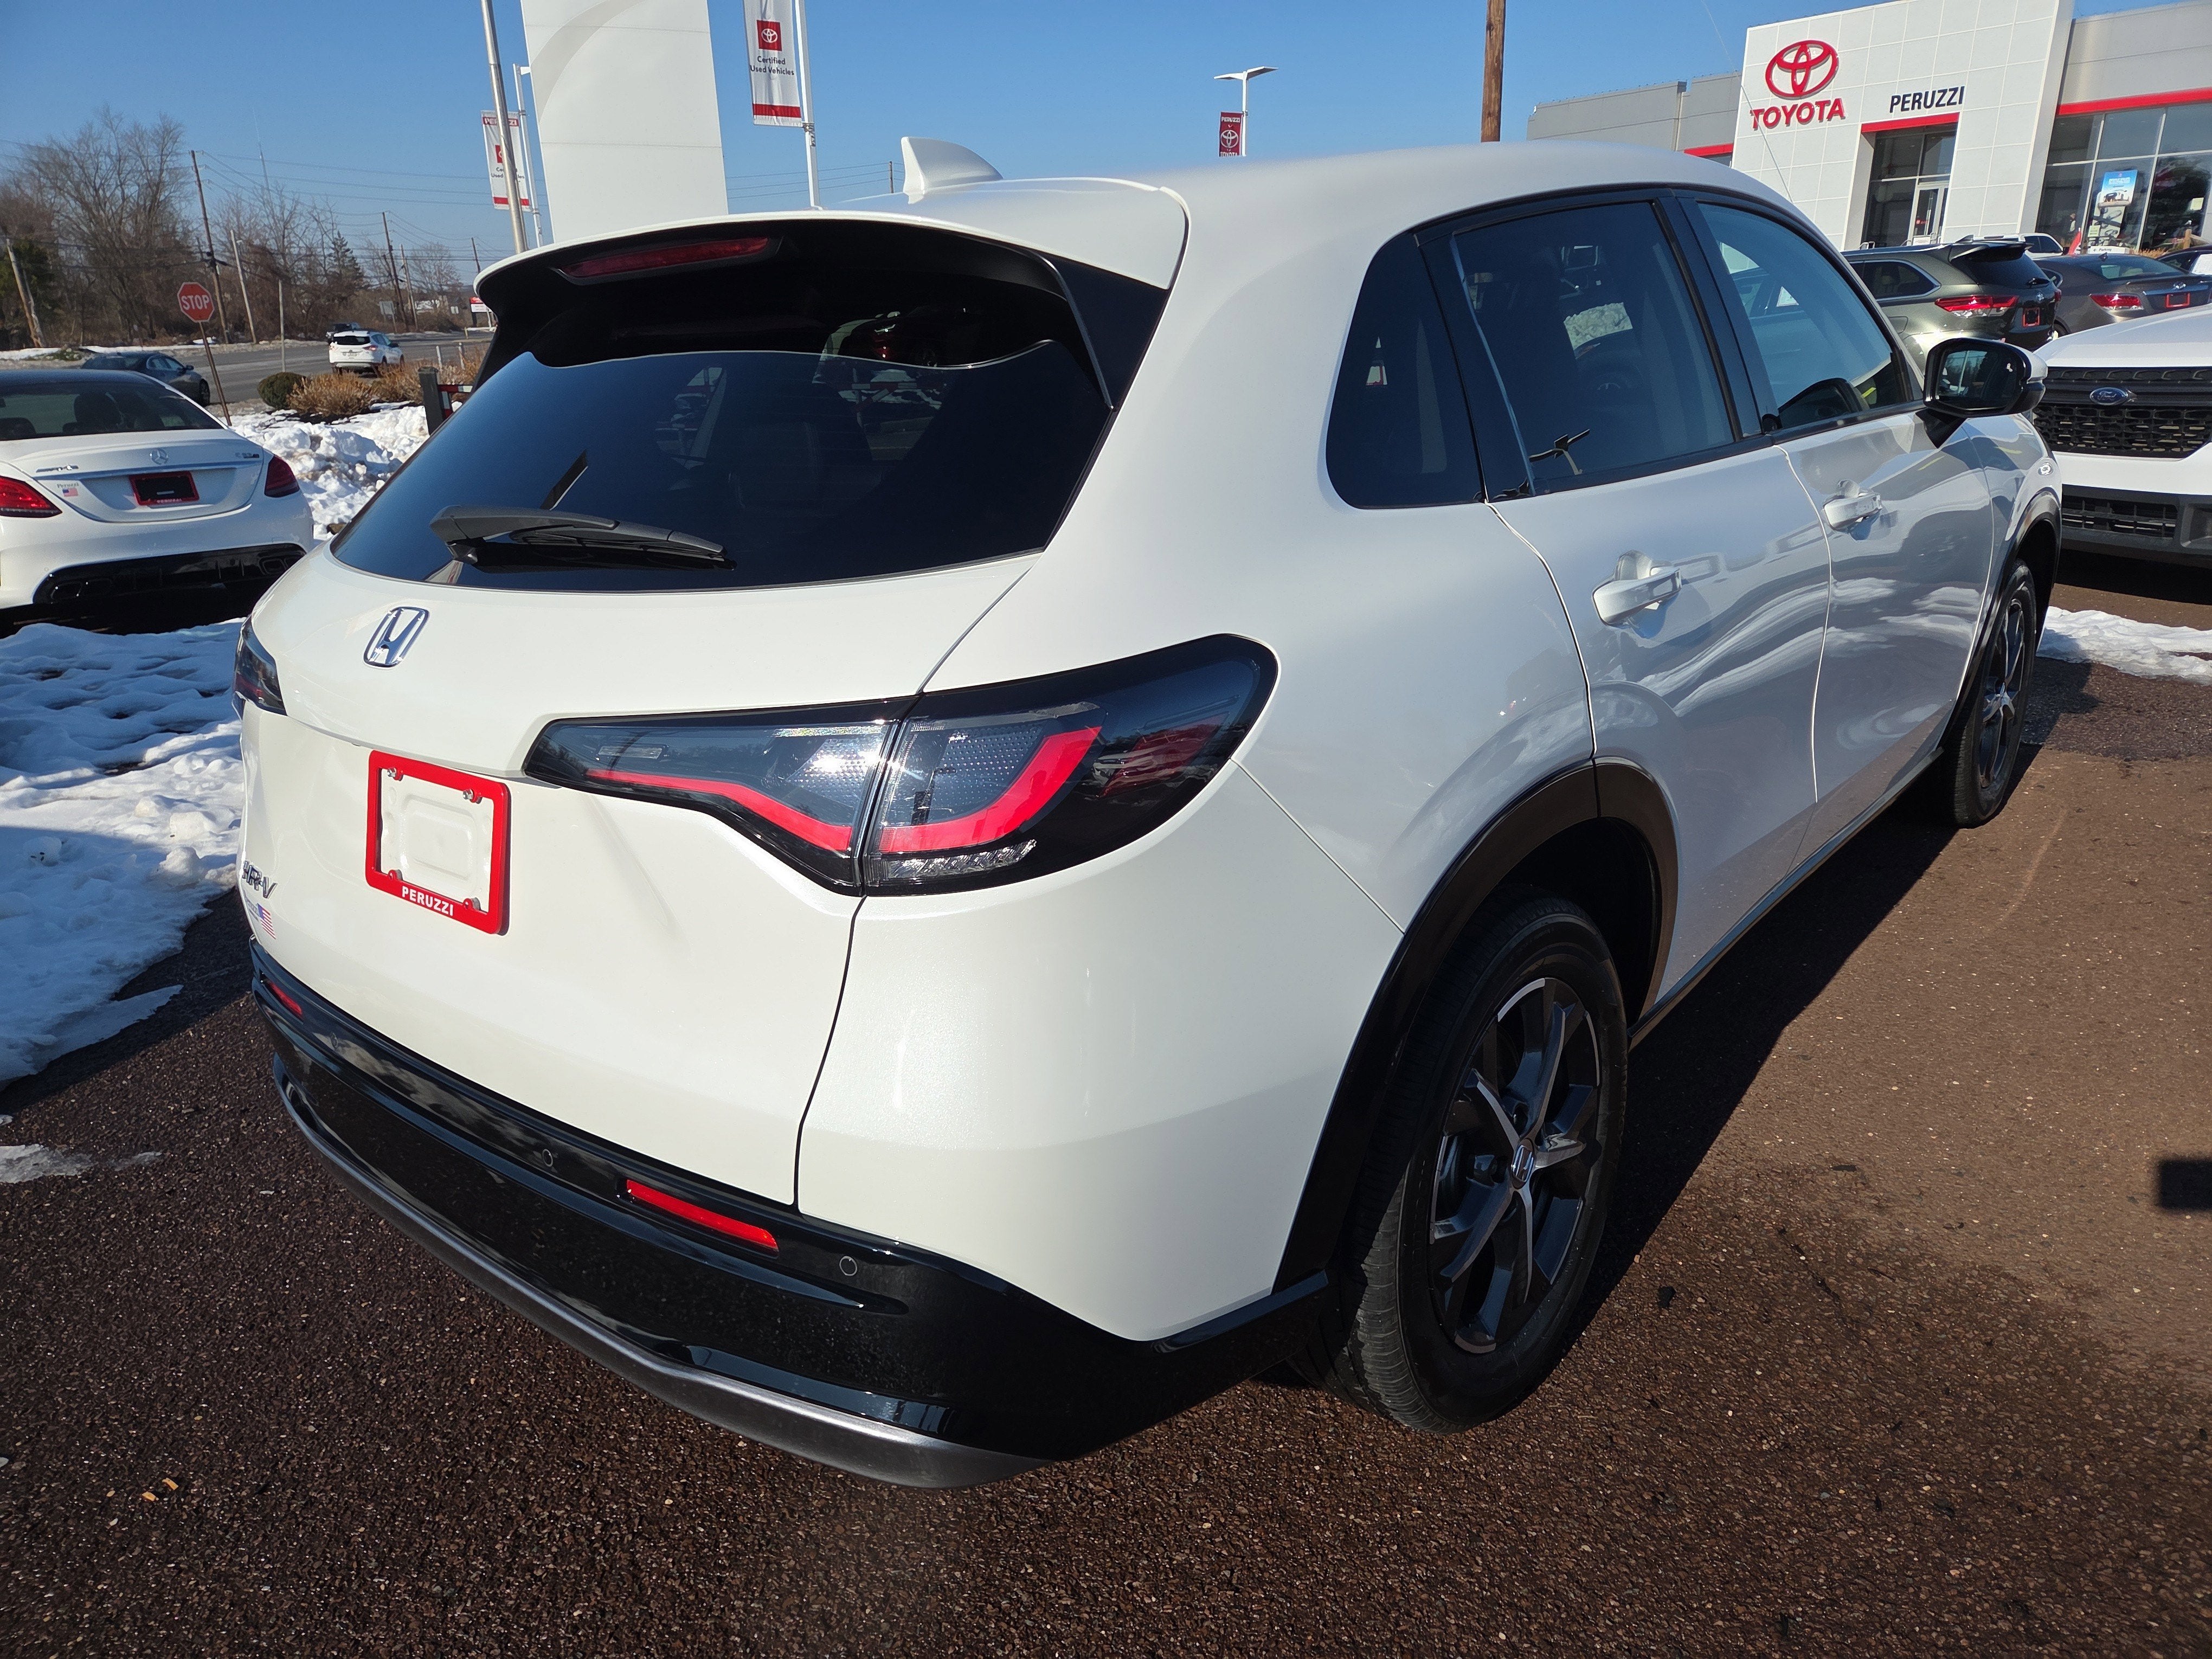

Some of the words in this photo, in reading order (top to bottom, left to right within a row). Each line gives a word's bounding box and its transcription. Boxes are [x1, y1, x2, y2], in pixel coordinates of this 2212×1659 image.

[757, 55, 786, 65] Certified
[768, 67, 794, 75] Vehicles
[1889, 86, 1965, 113] PERUZZI
[1750, 98, 1846, 131] TOYOTA
[181, 294, 210, 310] STOP
[2097, 390, 2117, 401] Ford
[242, 860, 278, 899] HR-V
[402, 885, 454, 916] PERUZZI
